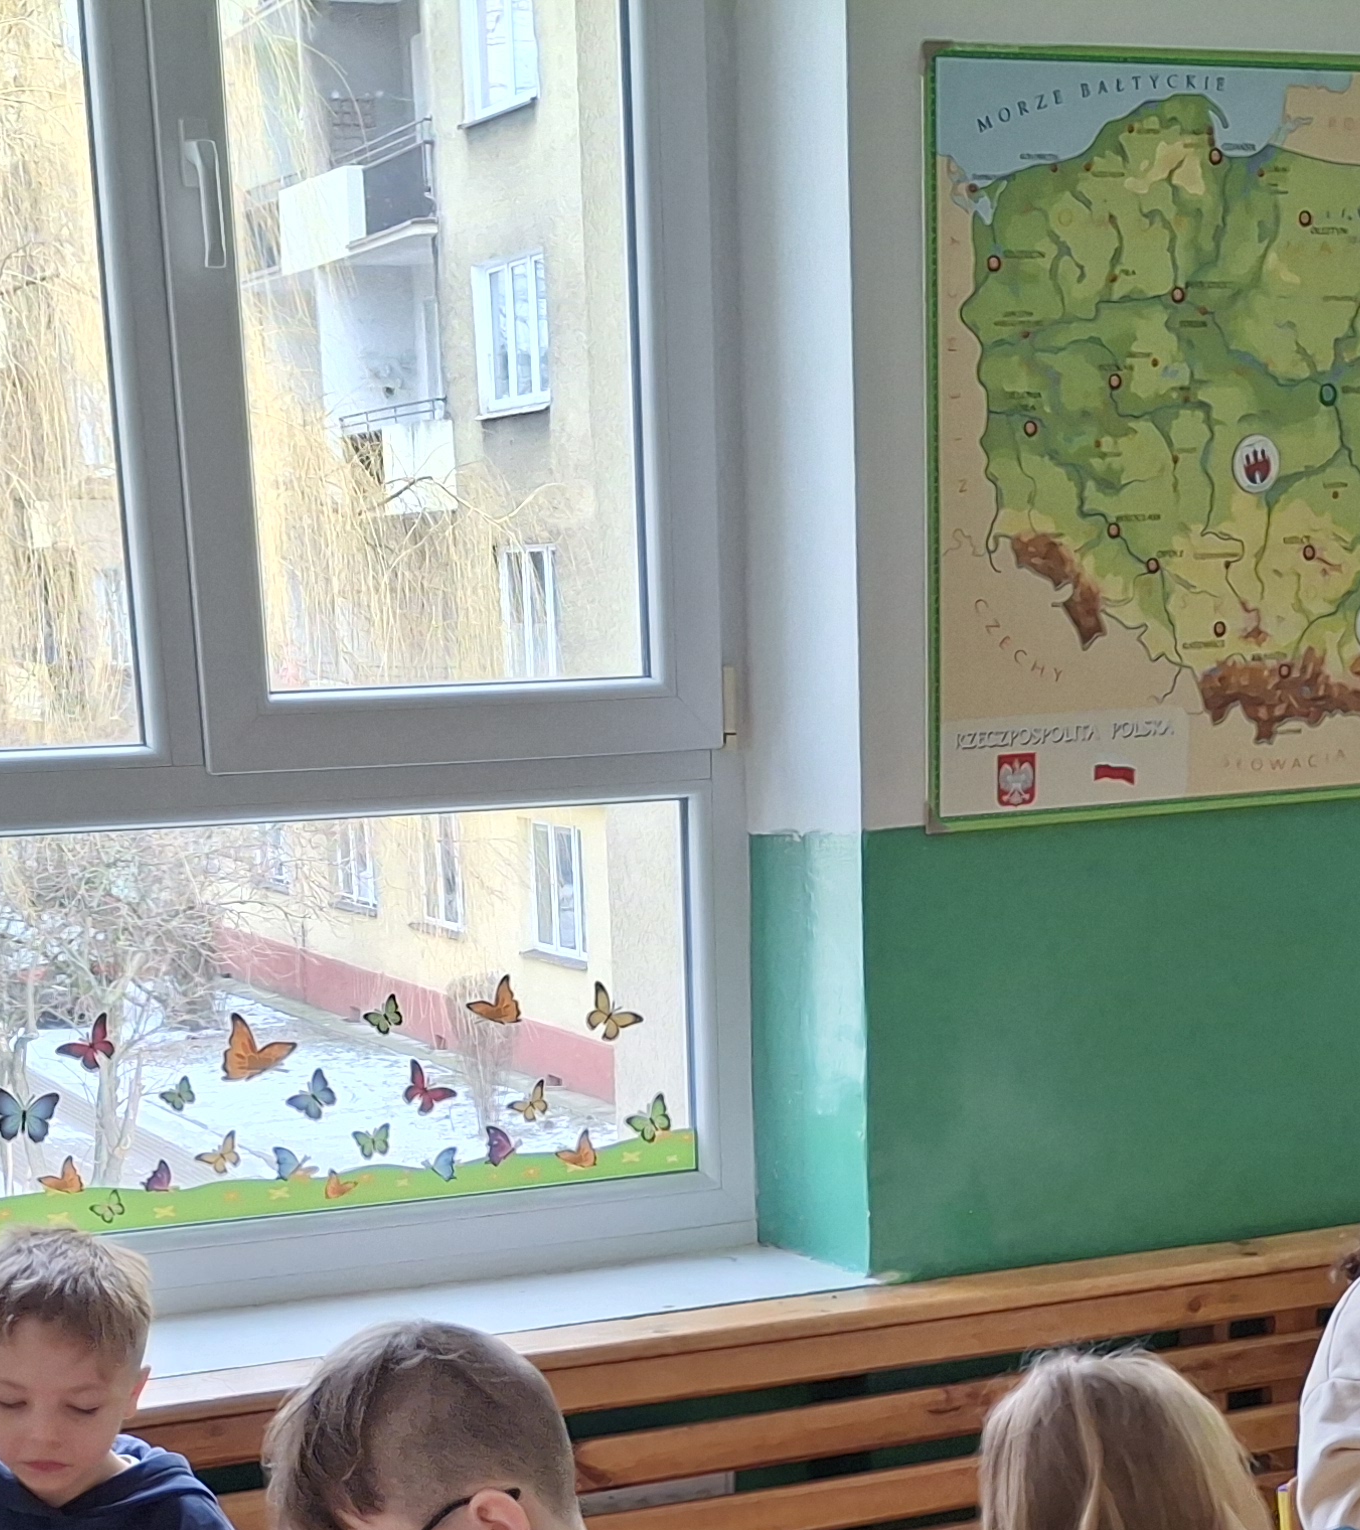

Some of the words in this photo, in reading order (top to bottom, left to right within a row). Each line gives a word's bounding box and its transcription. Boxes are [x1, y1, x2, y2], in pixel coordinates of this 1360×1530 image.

[976, 89, 1063, 132] MORZE
[1080, 74, 1225, 98] BAŁTYCKIE
[974, 598, 1063, 682] CZECHY
[955, 725, 1100, 750] RZECZPOSPOLITA
[1112, 719, 1176, 739] POLSKA
